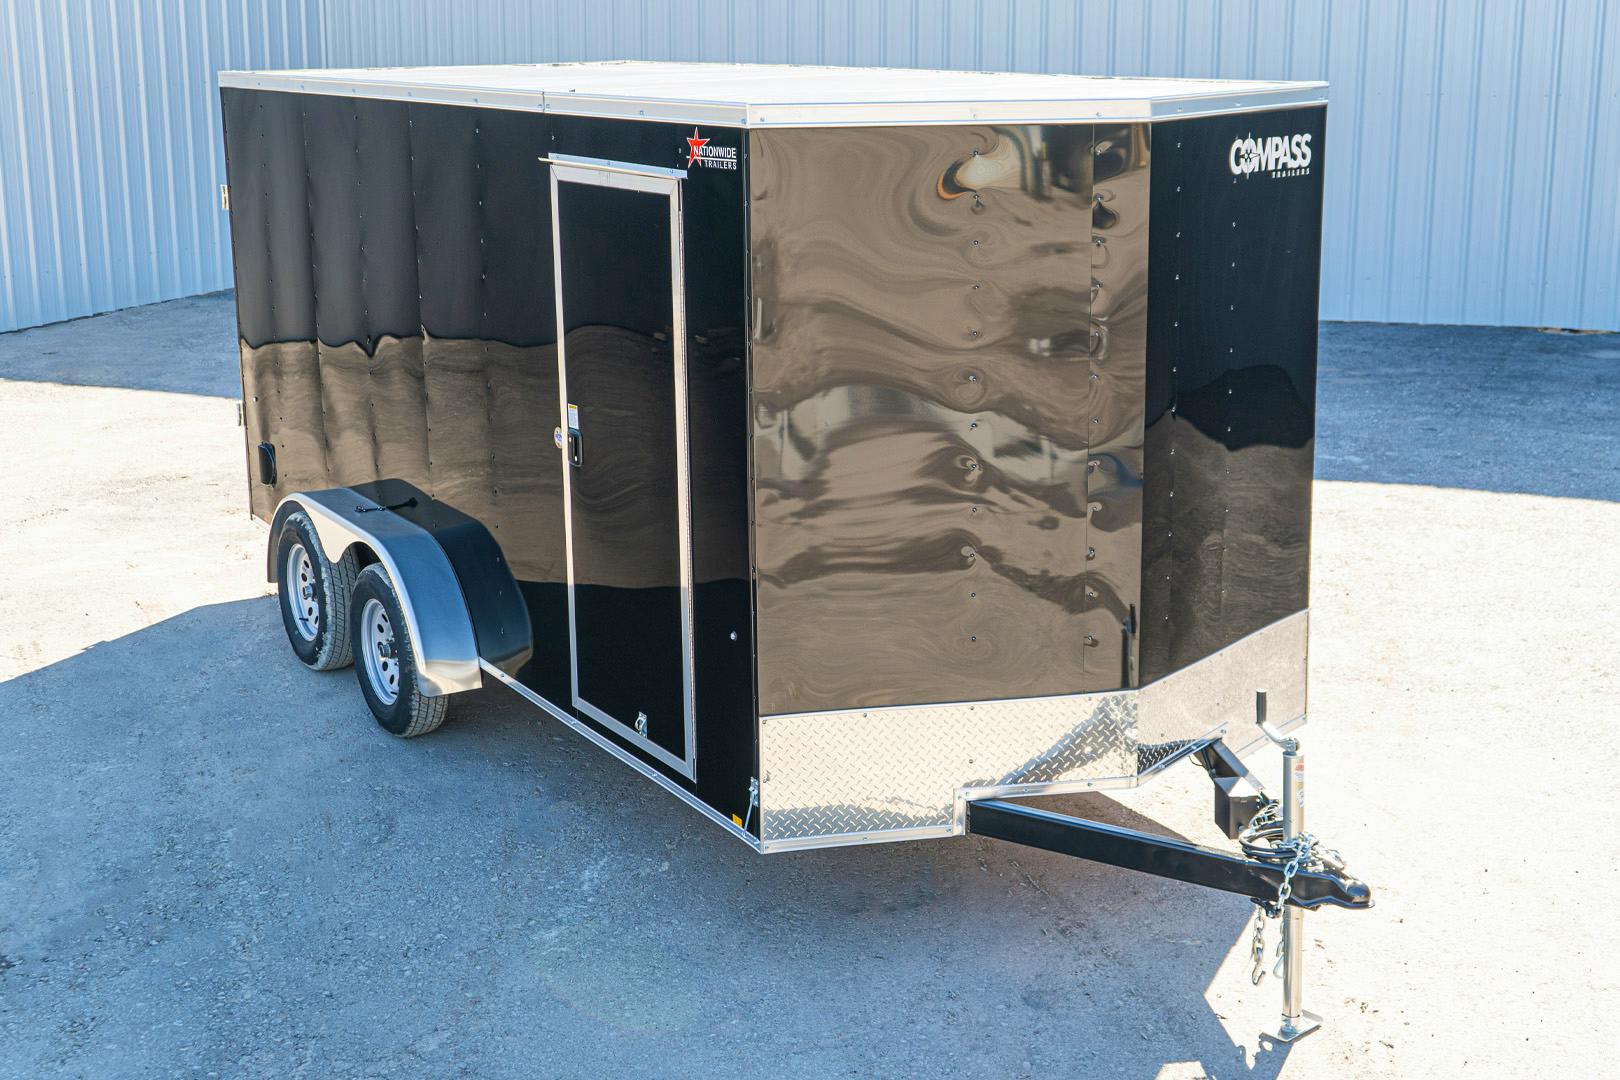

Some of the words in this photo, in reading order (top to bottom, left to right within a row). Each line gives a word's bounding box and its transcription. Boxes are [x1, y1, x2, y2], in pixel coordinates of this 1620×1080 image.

[694, 145, 737, 158] NATIONWIDE
[1230, 133, 1312, 175] COMPASS
[704, 160, 737, 170] TRAILERS
